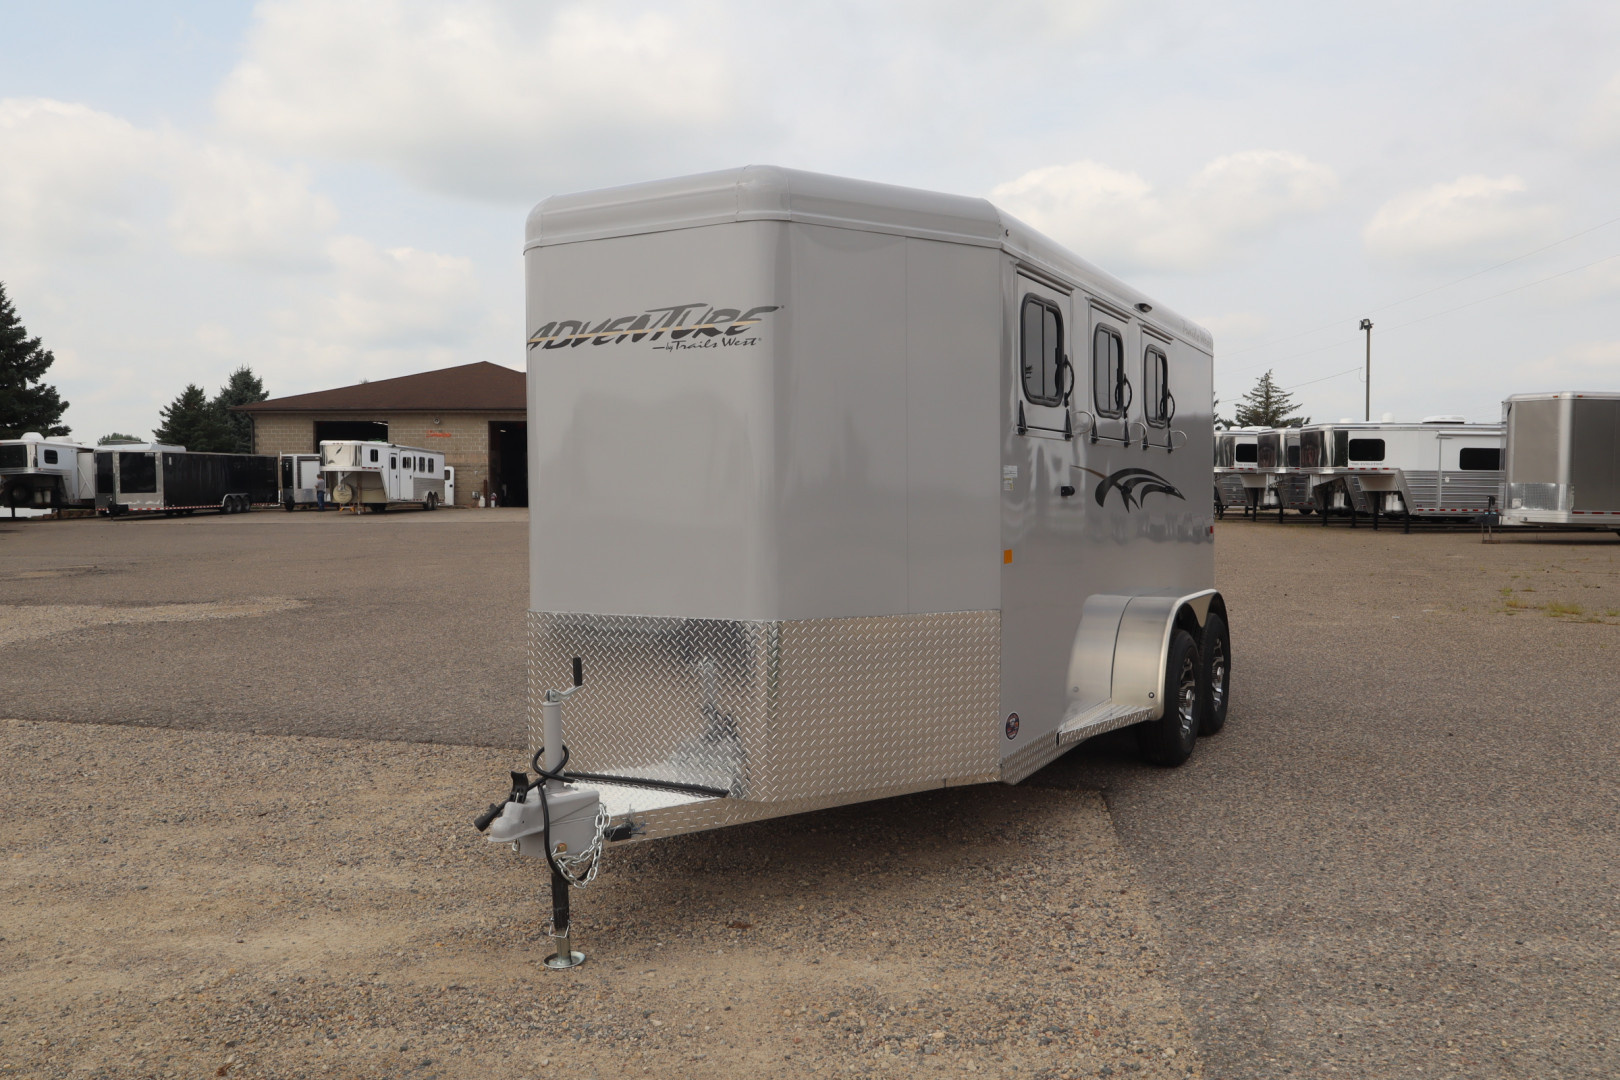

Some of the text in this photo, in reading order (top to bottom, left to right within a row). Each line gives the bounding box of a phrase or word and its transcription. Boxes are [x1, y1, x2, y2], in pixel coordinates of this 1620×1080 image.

[527, 303, 779, 350] ADVENTURE
[672, 338, 718, 350] Trails
[721, 337, 757, 347] West
